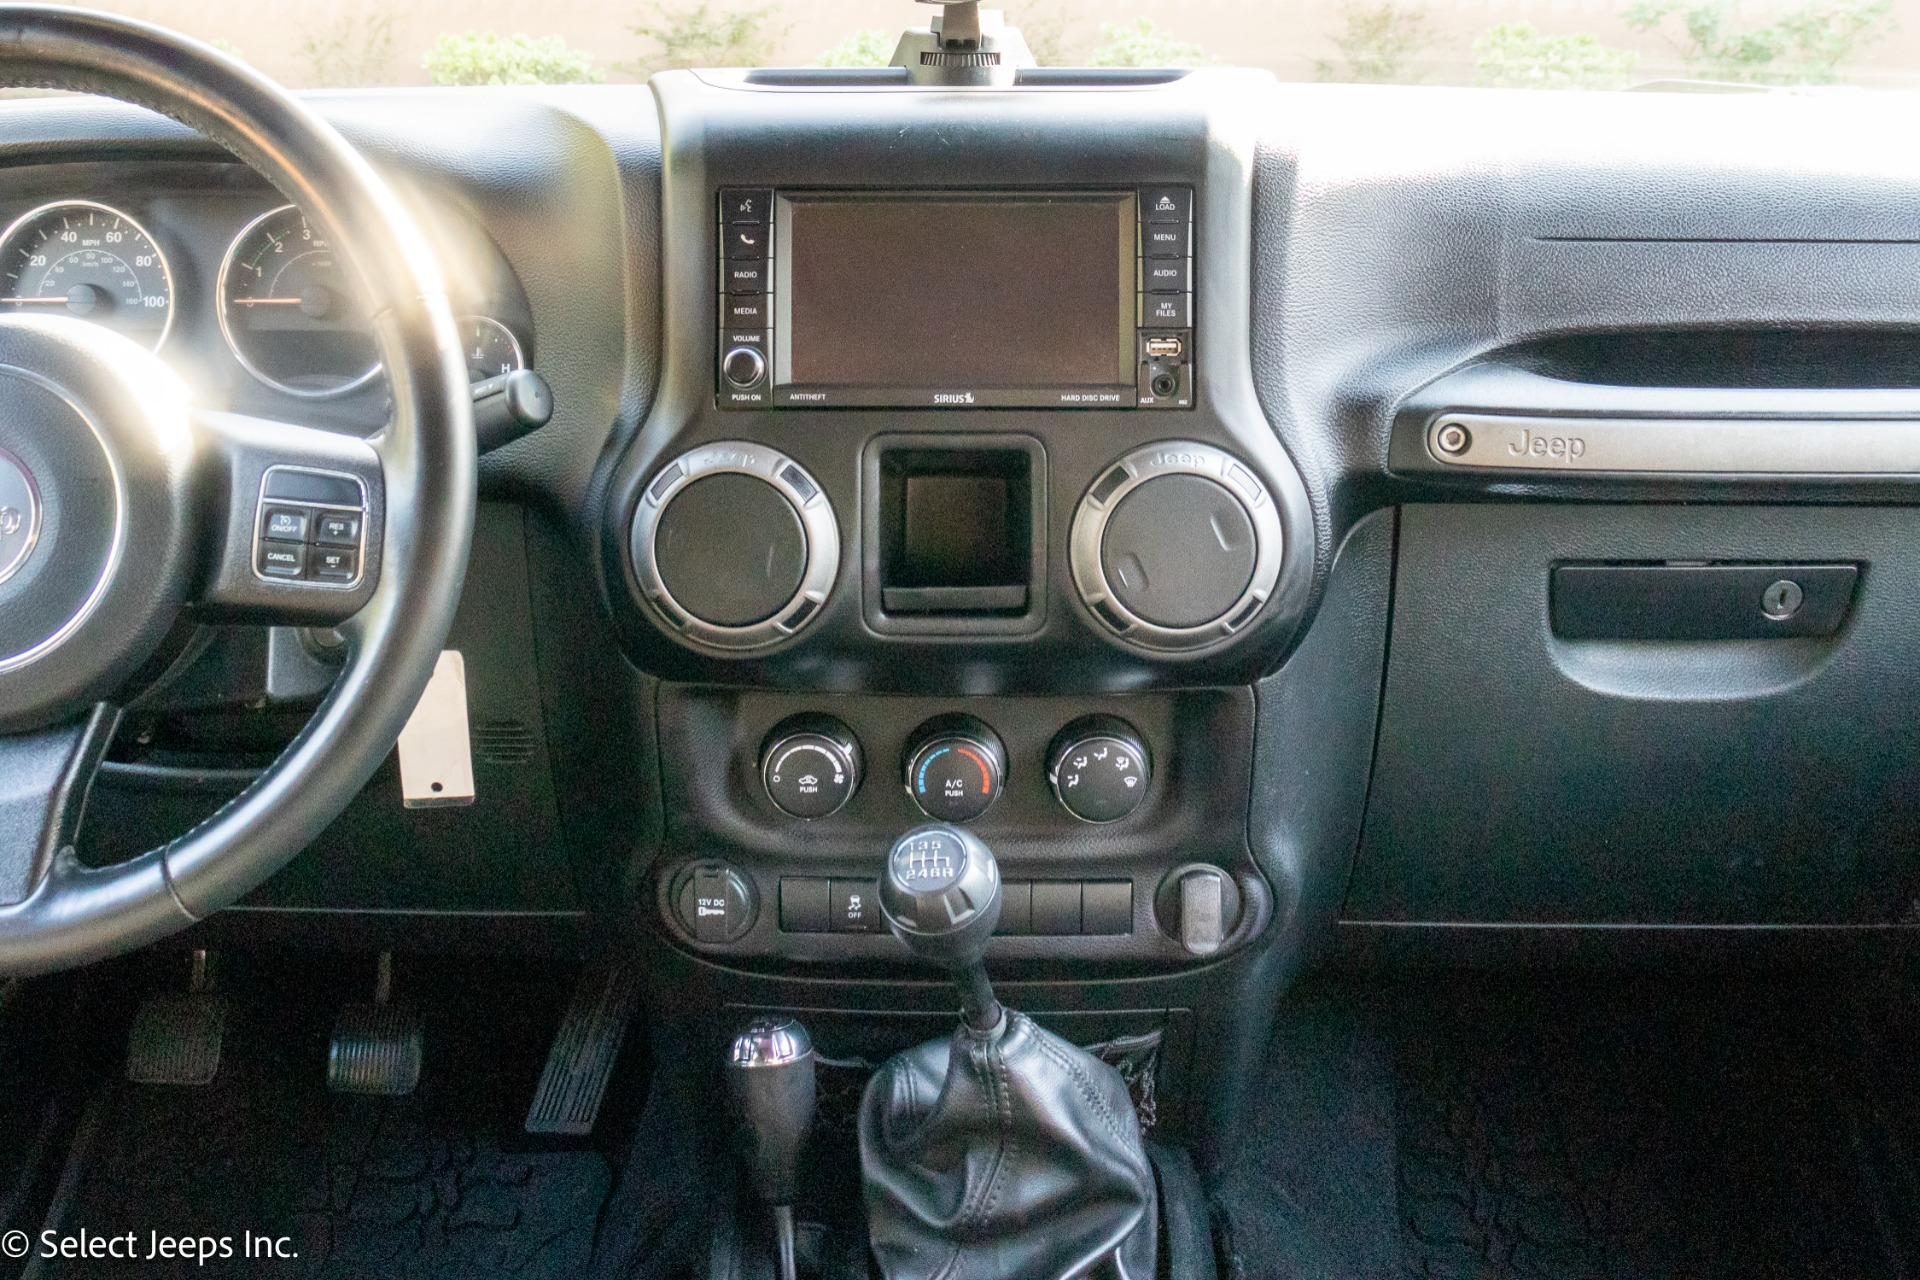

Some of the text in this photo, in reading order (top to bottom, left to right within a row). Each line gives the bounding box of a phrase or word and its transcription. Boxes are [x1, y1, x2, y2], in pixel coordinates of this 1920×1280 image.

[1155, 203, 1175, 211] LOAD
[61, 231, 78, 242] 40
[106, 232, 122, 243] 60
[303, 229, 311, 240] 3
[1153, 233, 1176, 241] MENU
[275, 242, 283, 253] 2
[30, 255, 46, 266] 20
[135, 256, 152, 267] 80
[255, 266, 262, 277] 1
[734, 271, 758, 279] RADIO
[1153, 269, 1177, 277] AUDIO
[143, 296, 165, 307] 100
[733, 335, 760, 343] VOLUME
[501, 363, 510, 373] H
[933, 394, 965, 404] SIRIUS
[1061, 394, 1120, 402] HARD DISC DRIVE
[1508, 429, 1586, 463] Jeep
[1150, 452, 1206, 468] Jeep
[271, 525, 298, 533] ON/OFF
[329, 523, 344, 531] RES
[267, 552, 295, 562] CANCEL
[326, 556, 340, 564] SET
[945, 779, 963, 789] A/C
[847, 911, 862, 919] OFF
